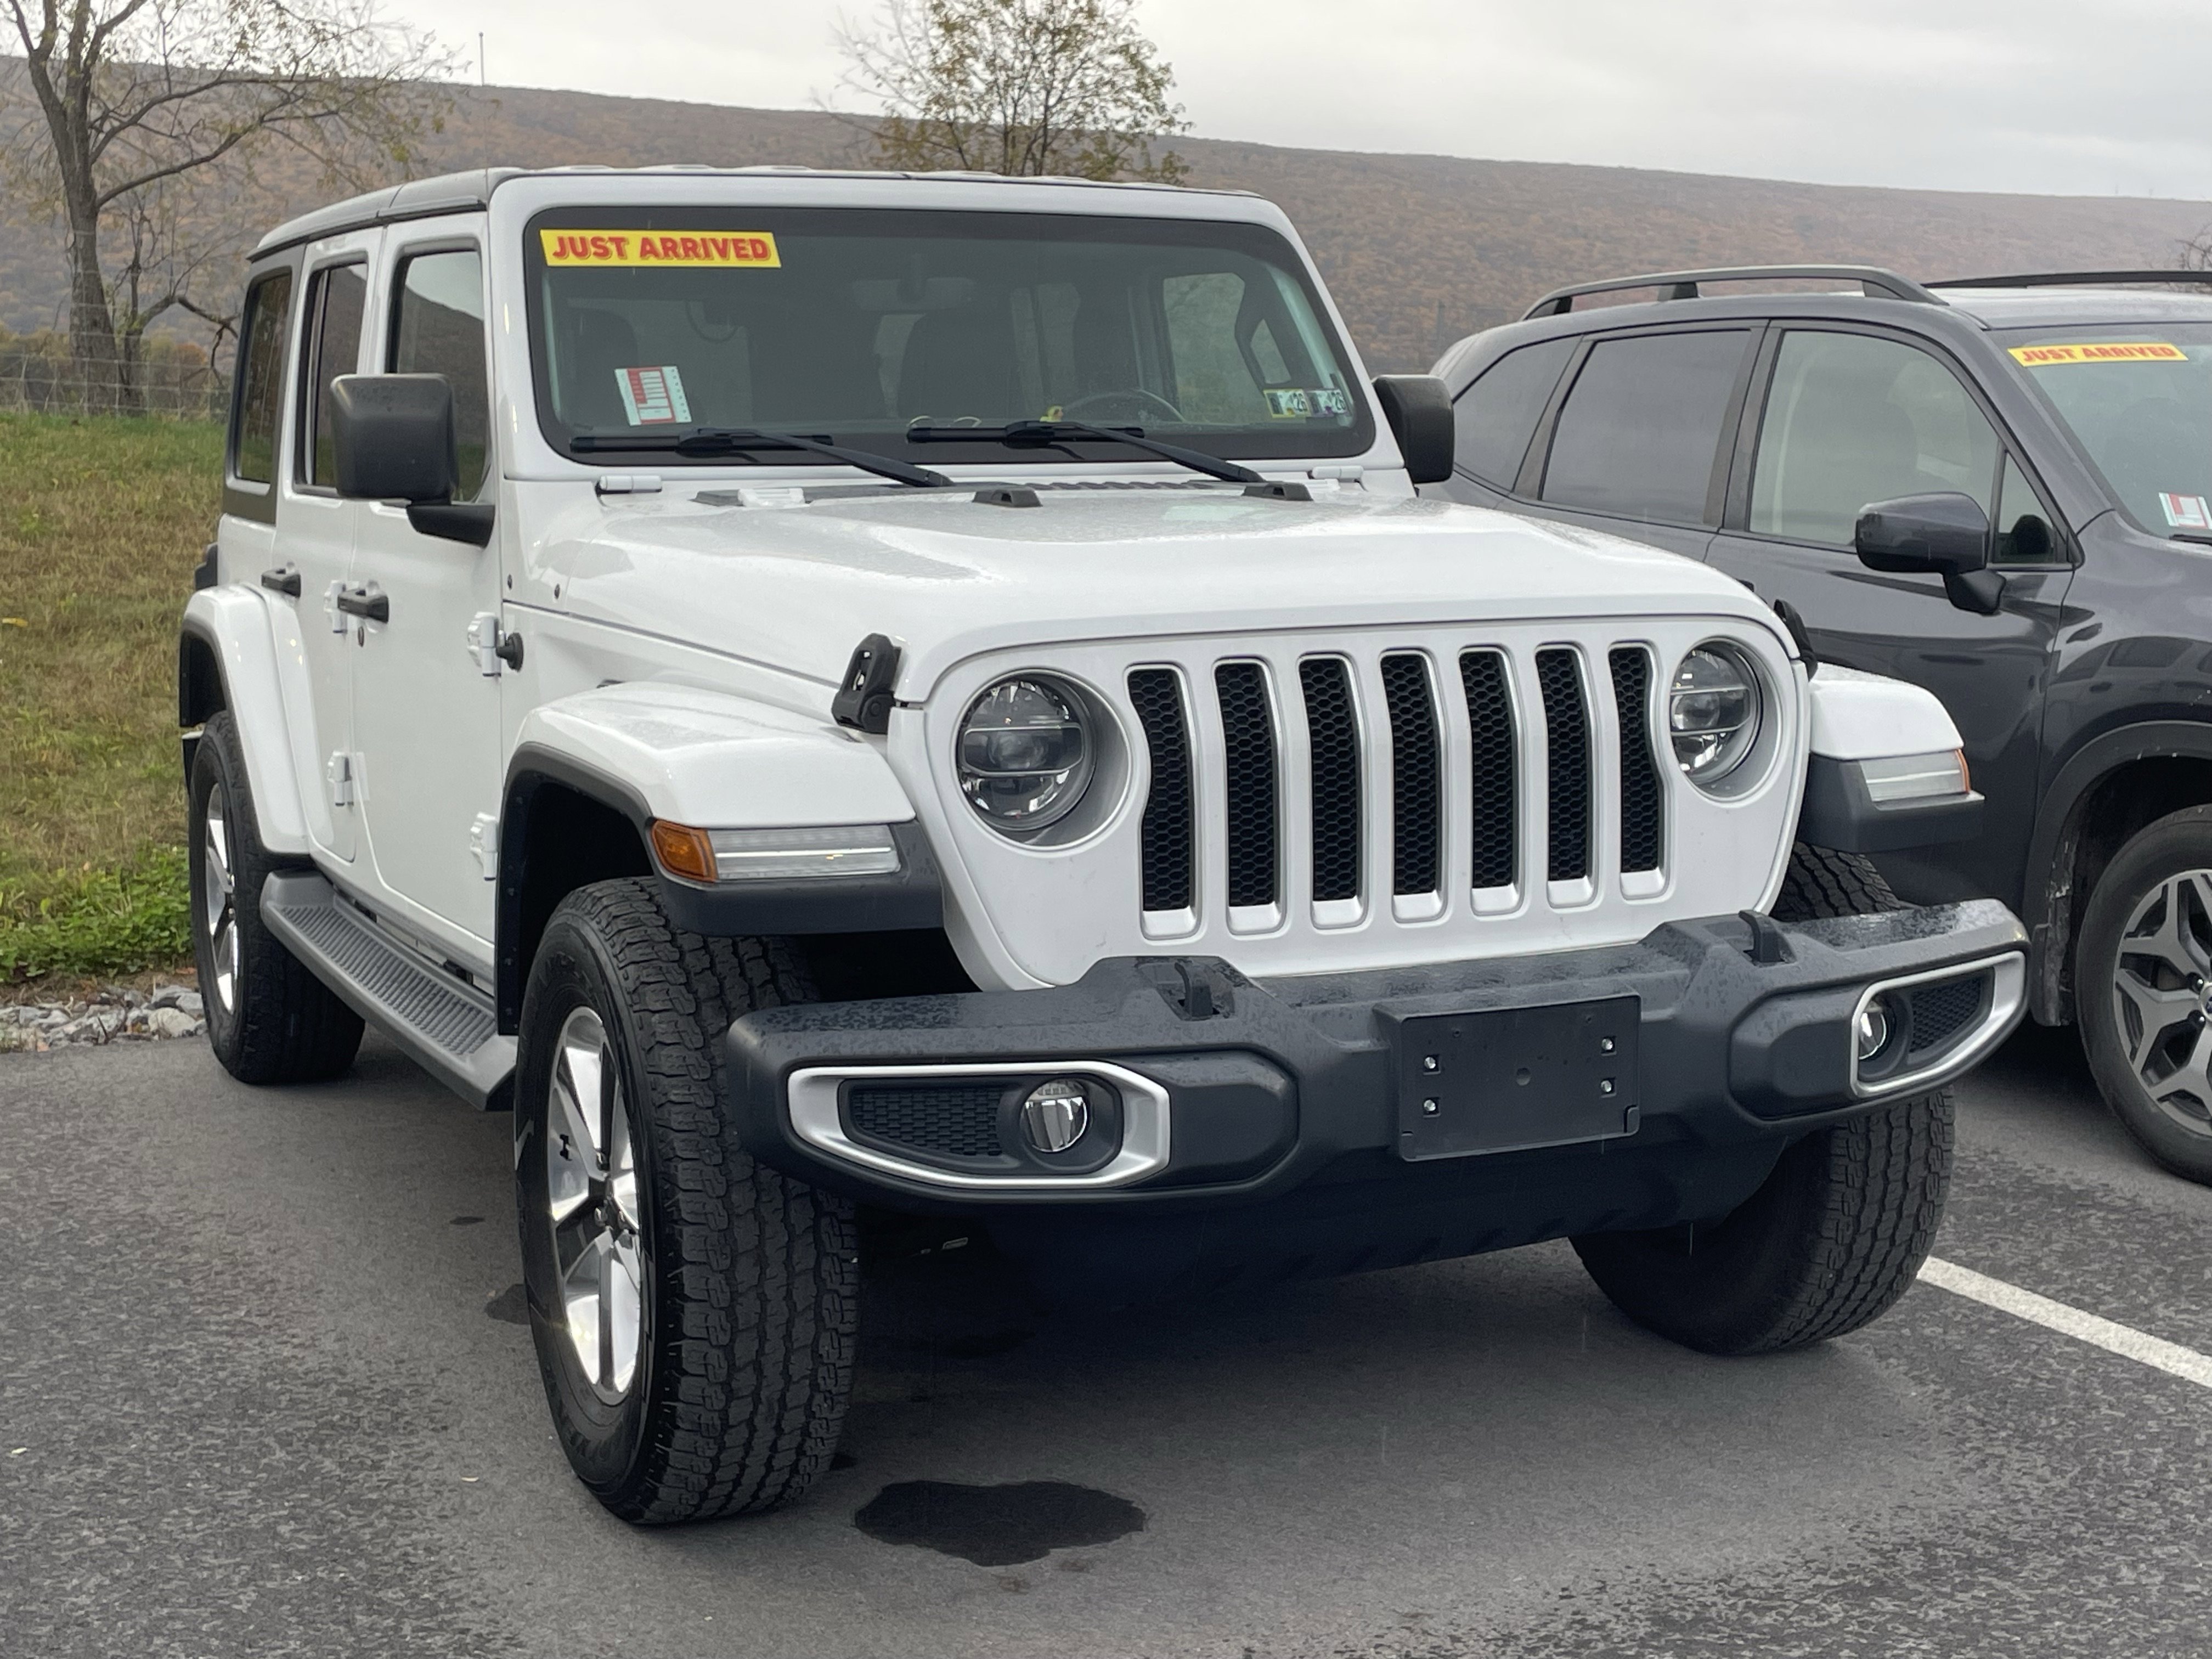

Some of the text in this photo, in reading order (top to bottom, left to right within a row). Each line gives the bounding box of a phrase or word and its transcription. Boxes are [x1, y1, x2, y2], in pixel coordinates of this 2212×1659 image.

[552, 236, 771, 260] JUST ARRIVED
[2022, 346, 2178, 362] JUST ARRIVED
